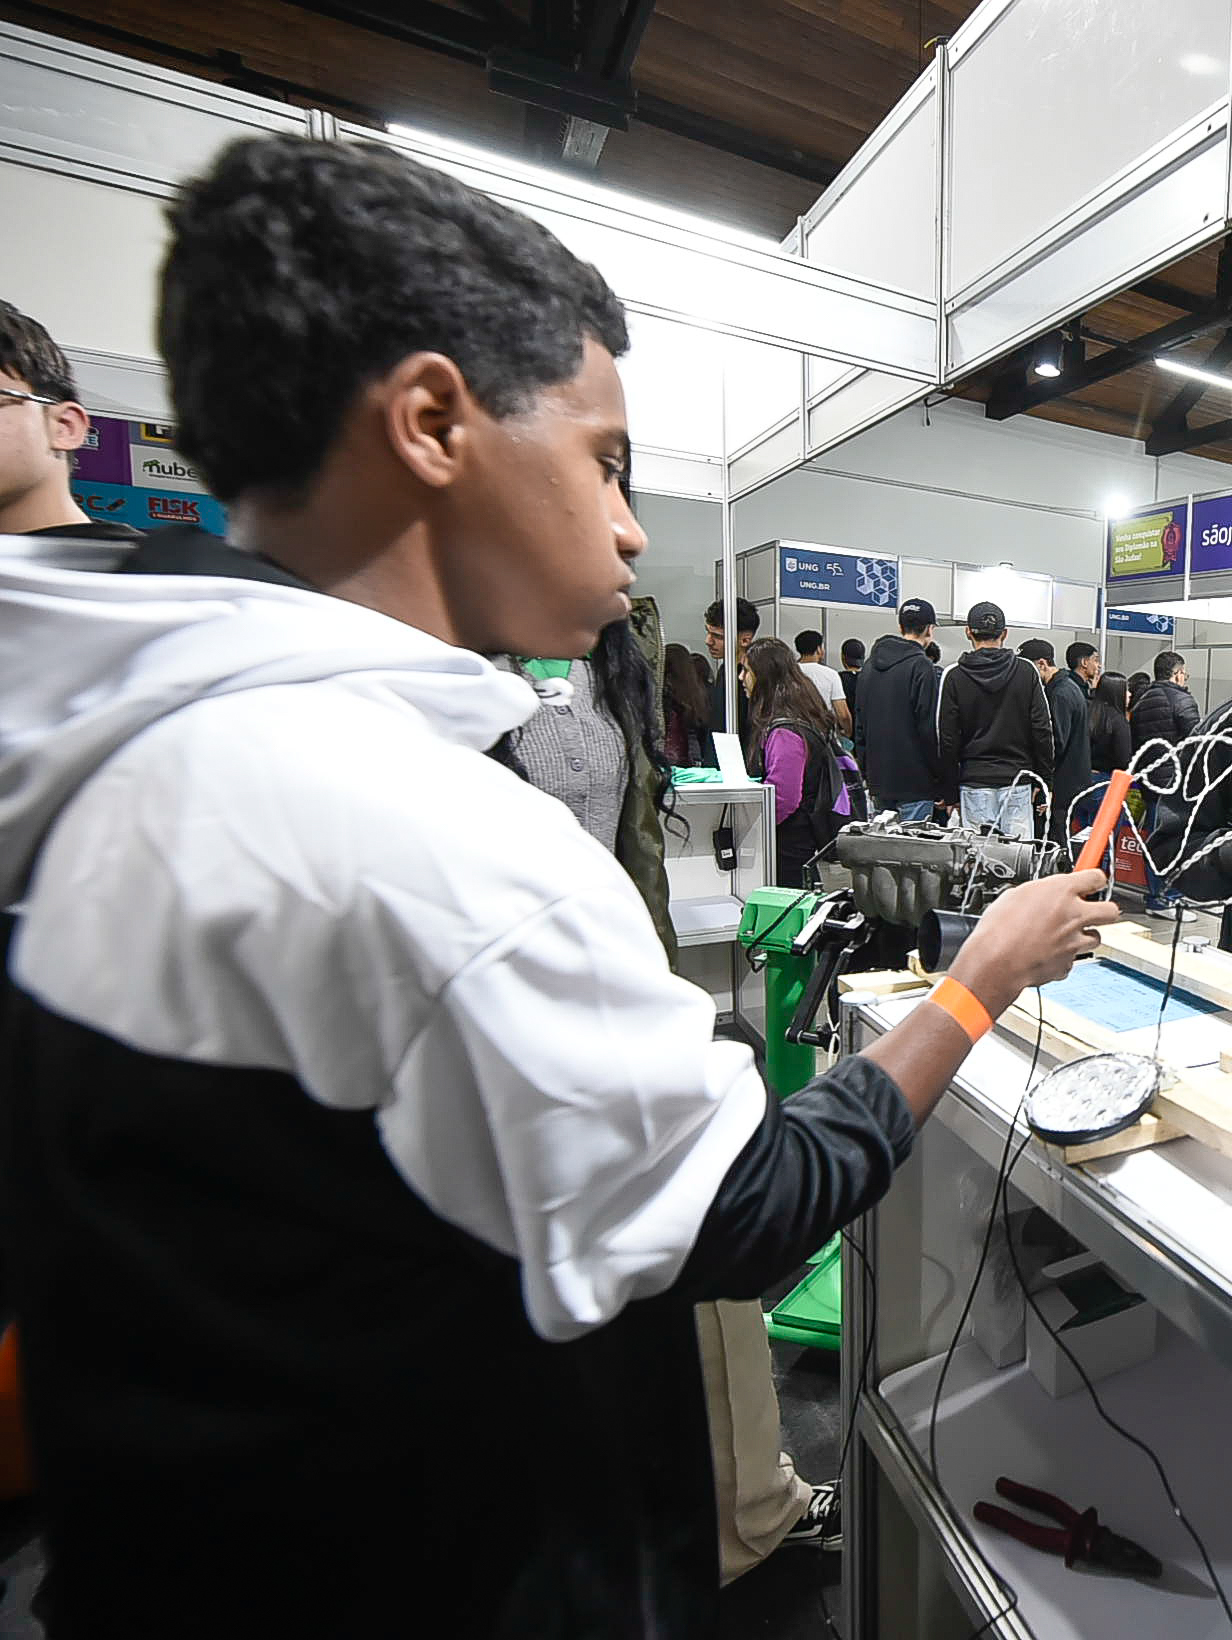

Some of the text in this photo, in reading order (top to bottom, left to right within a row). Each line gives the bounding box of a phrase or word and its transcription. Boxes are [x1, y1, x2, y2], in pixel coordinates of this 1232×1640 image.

[148, 497, 200, 515] FISK
[798, 562, 819, 572] UNG
[799, 581, 831, 590] UNG.BR
